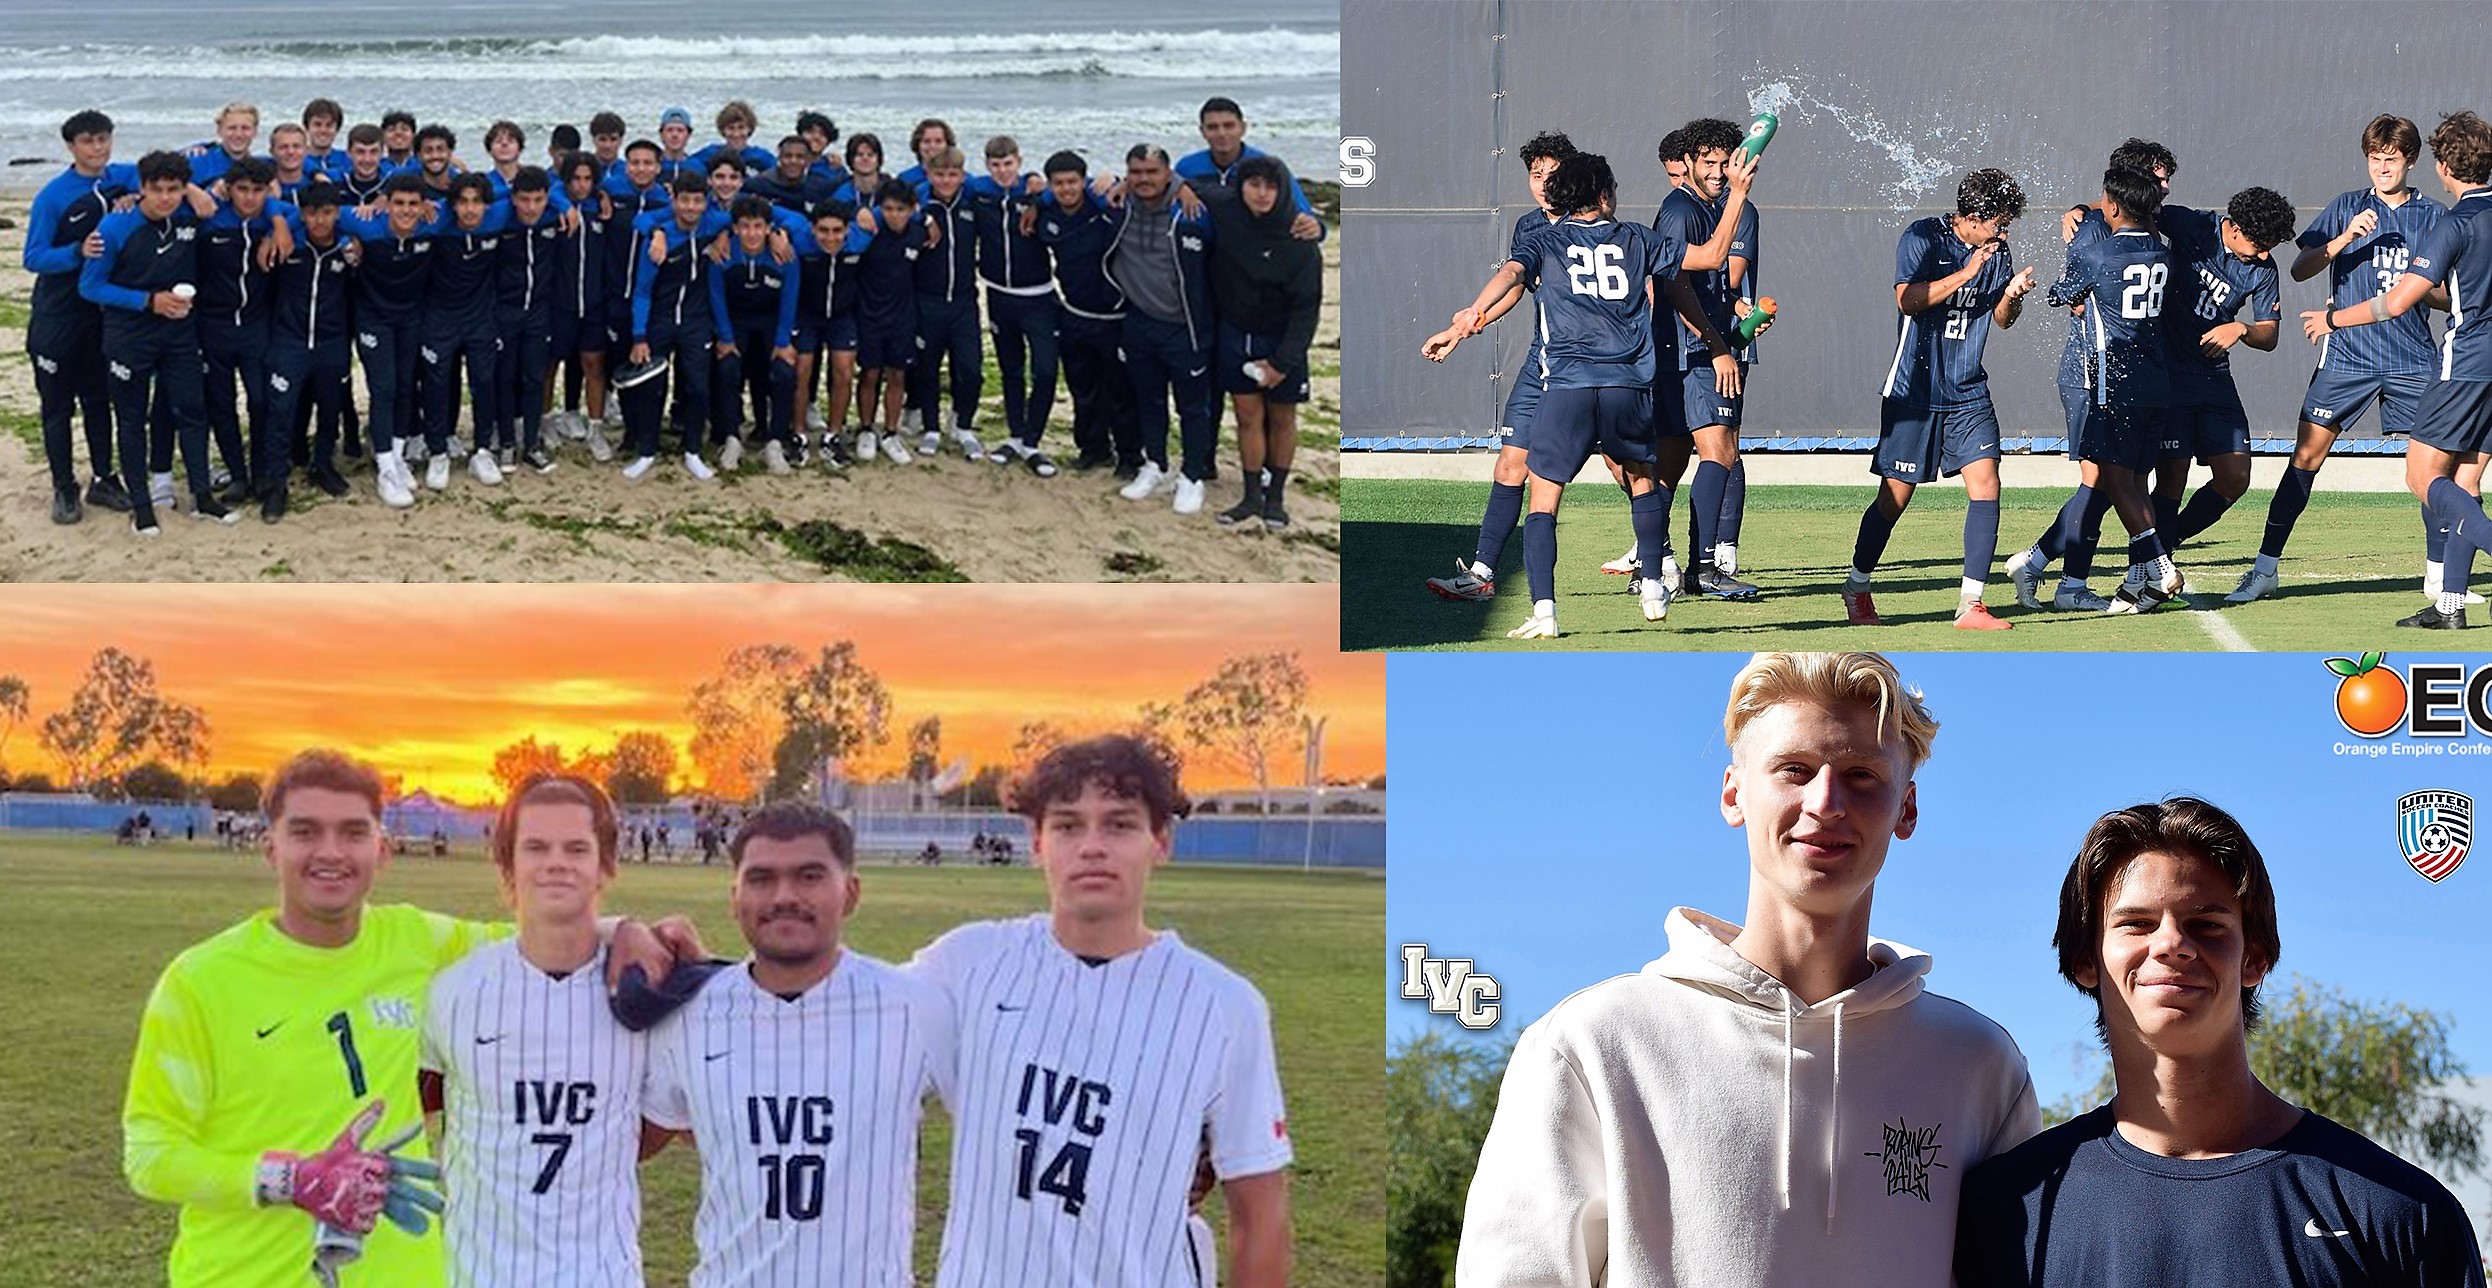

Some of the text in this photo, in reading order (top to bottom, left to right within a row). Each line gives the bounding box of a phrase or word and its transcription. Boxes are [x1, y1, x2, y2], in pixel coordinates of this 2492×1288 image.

[1340, 136, 1376, 188] S
[1566, 243, 1630, 301] 26
[2372, 245, 2410, 270] IVC
[2377, 270, 2401, 297] 3
[2121, 262, 2169, 320] 28
[2194, 289, 2218, 321] 16
[1944, 309, 1969, 341] 21
[1894, 460, 1916, 473] IVC
[326, 1011, 367, 1099] 1
[514, 1080, 597, 1126] IVC
[747, 1096, 834, 1146] IVC
[1016, 1063, 1112, 1139] IVC
[530, 1133, 574, 1195] 7
[757, 1154, 826, 1221] 10
[1014, 1128, 1094, 1217] 14
